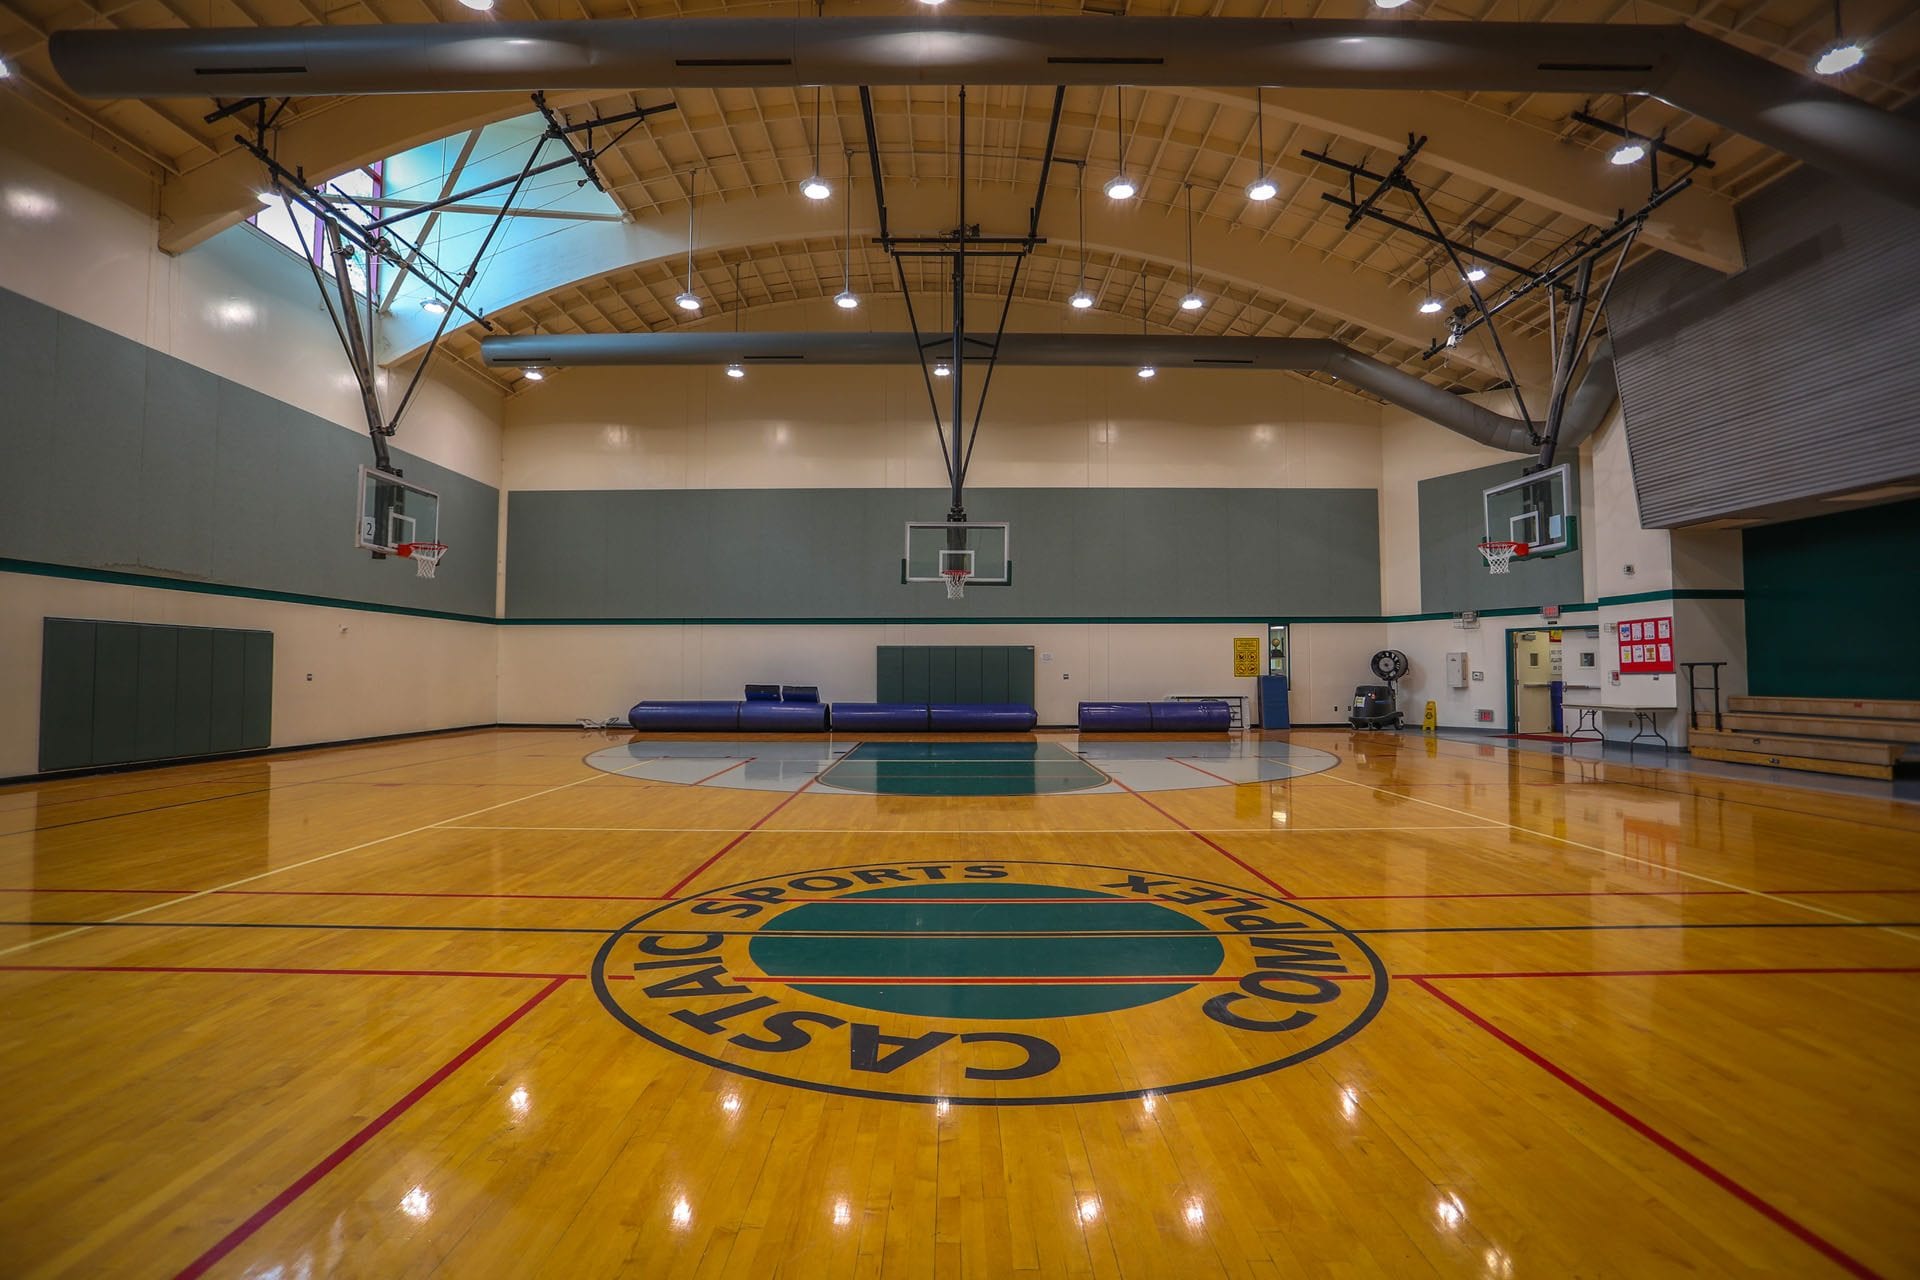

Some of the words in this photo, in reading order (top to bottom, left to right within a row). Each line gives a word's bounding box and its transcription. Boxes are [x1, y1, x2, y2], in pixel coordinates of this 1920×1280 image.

[366, 522, 373, 536] 2
[690, 865, 1009, 919] SPORTS
[1100, 874, 1348, 1032] COMPLEX
[634, 932, 1061, 1081] CASTAIC
